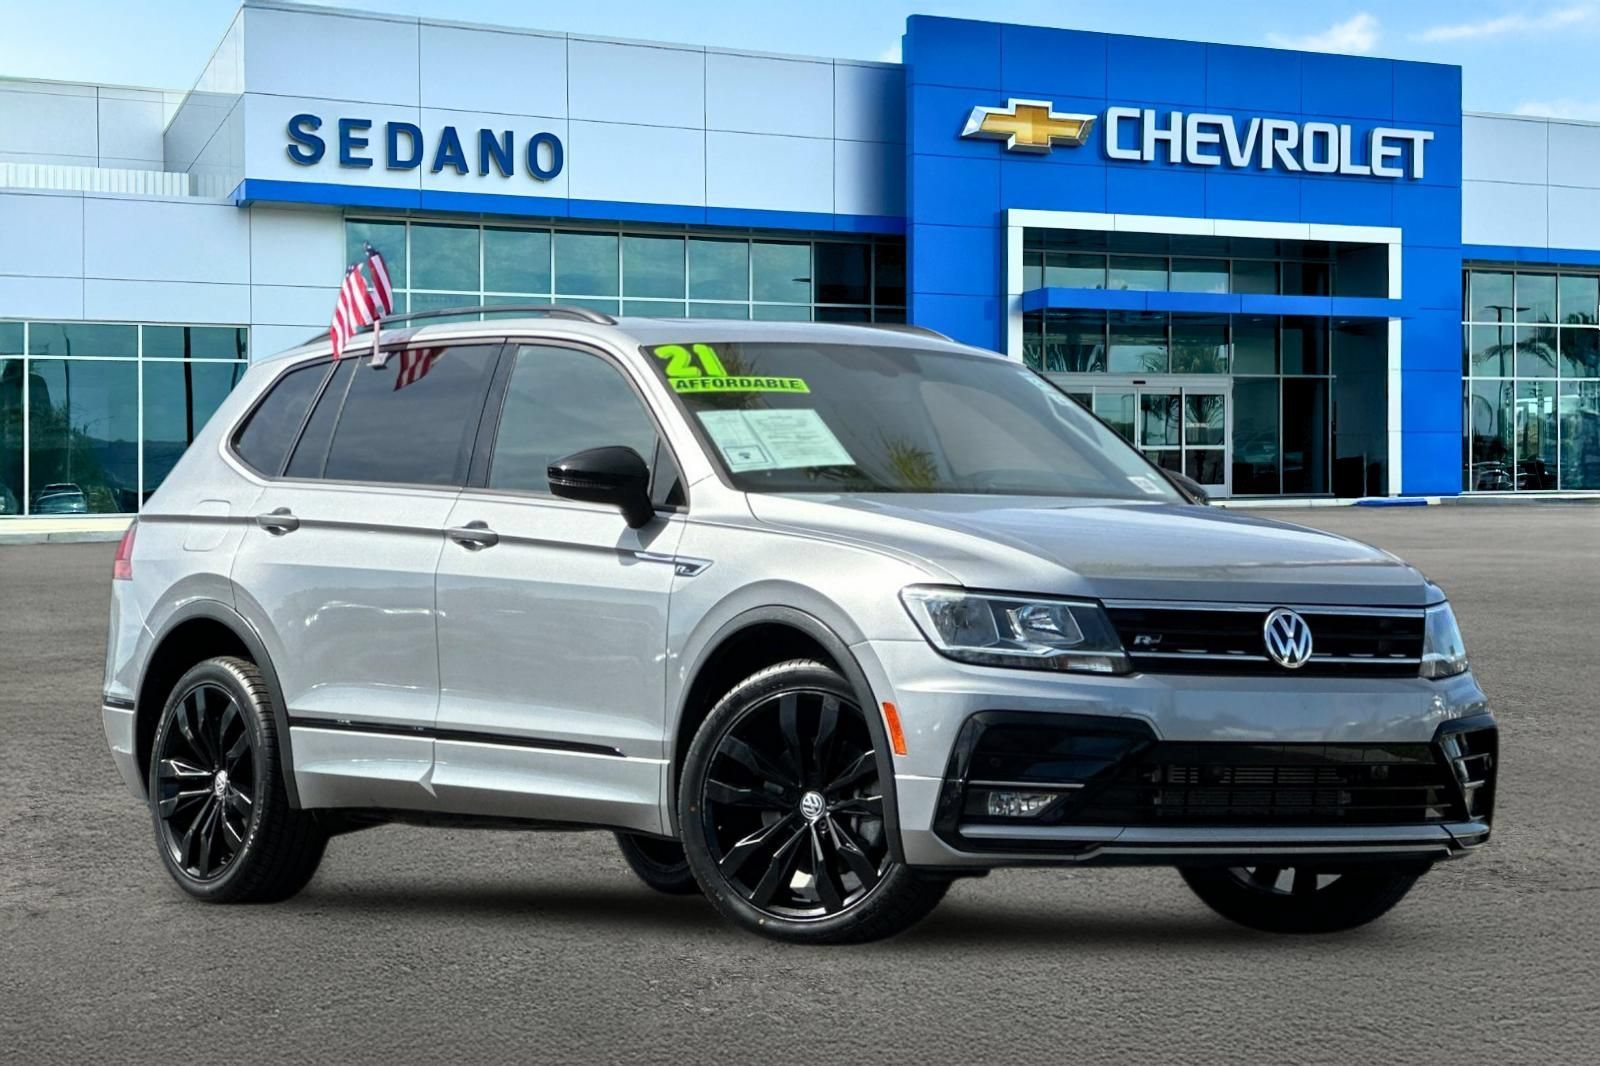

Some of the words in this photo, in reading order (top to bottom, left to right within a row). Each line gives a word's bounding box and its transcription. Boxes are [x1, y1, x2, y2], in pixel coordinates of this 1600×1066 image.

[286, 113, 564, 181] SEDANO
[1105, 105, 1435, 180] CHEVROLET
[654, 343, 729, 377] 21
[675, 378, 801, 390] AFFORDABLE
[1264, 608, 1313, 669] VW
